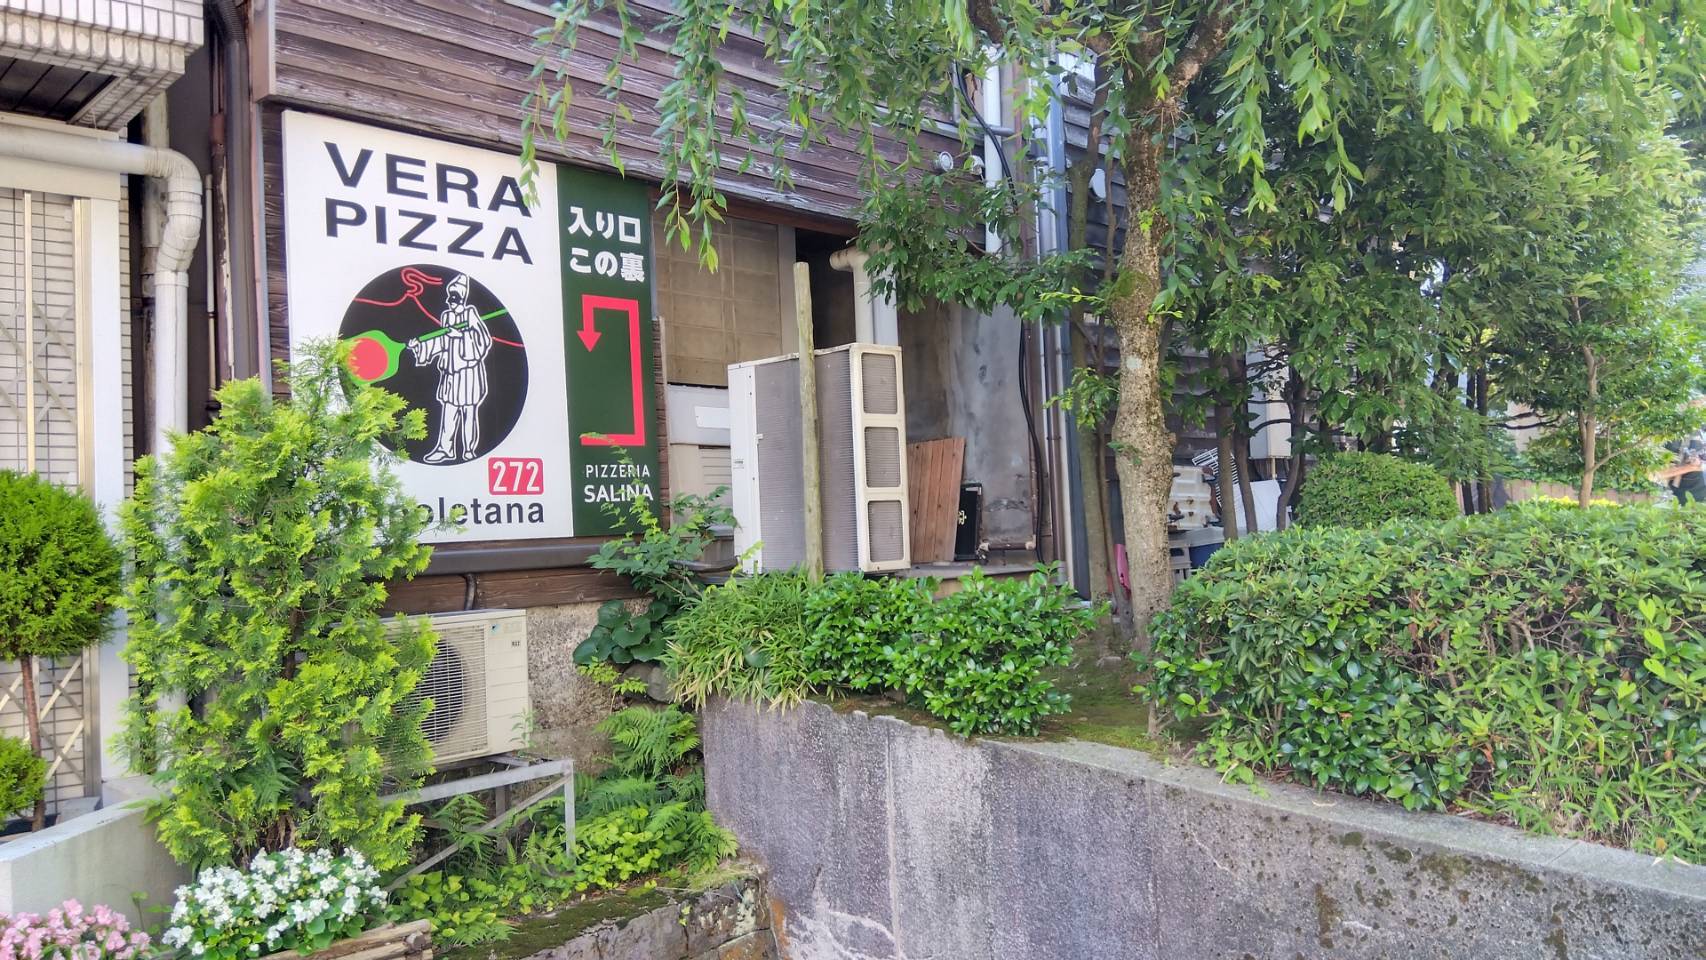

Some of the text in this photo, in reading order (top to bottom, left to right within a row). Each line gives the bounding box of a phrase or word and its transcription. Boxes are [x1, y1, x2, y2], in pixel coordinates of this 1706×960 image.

[324, 141, 532, 218] VERA
[325, 197, 534, 265] PIZZA
[567, 206, 642, 244] 入り口
[569, 247, 645, 283] この裏
[492, 461, 540, 492] 272
[585, 464, 650, 478] PIZZERIA
[584, 484, 654, 503] SALINA
[412, 497, 544, 525] oletana
